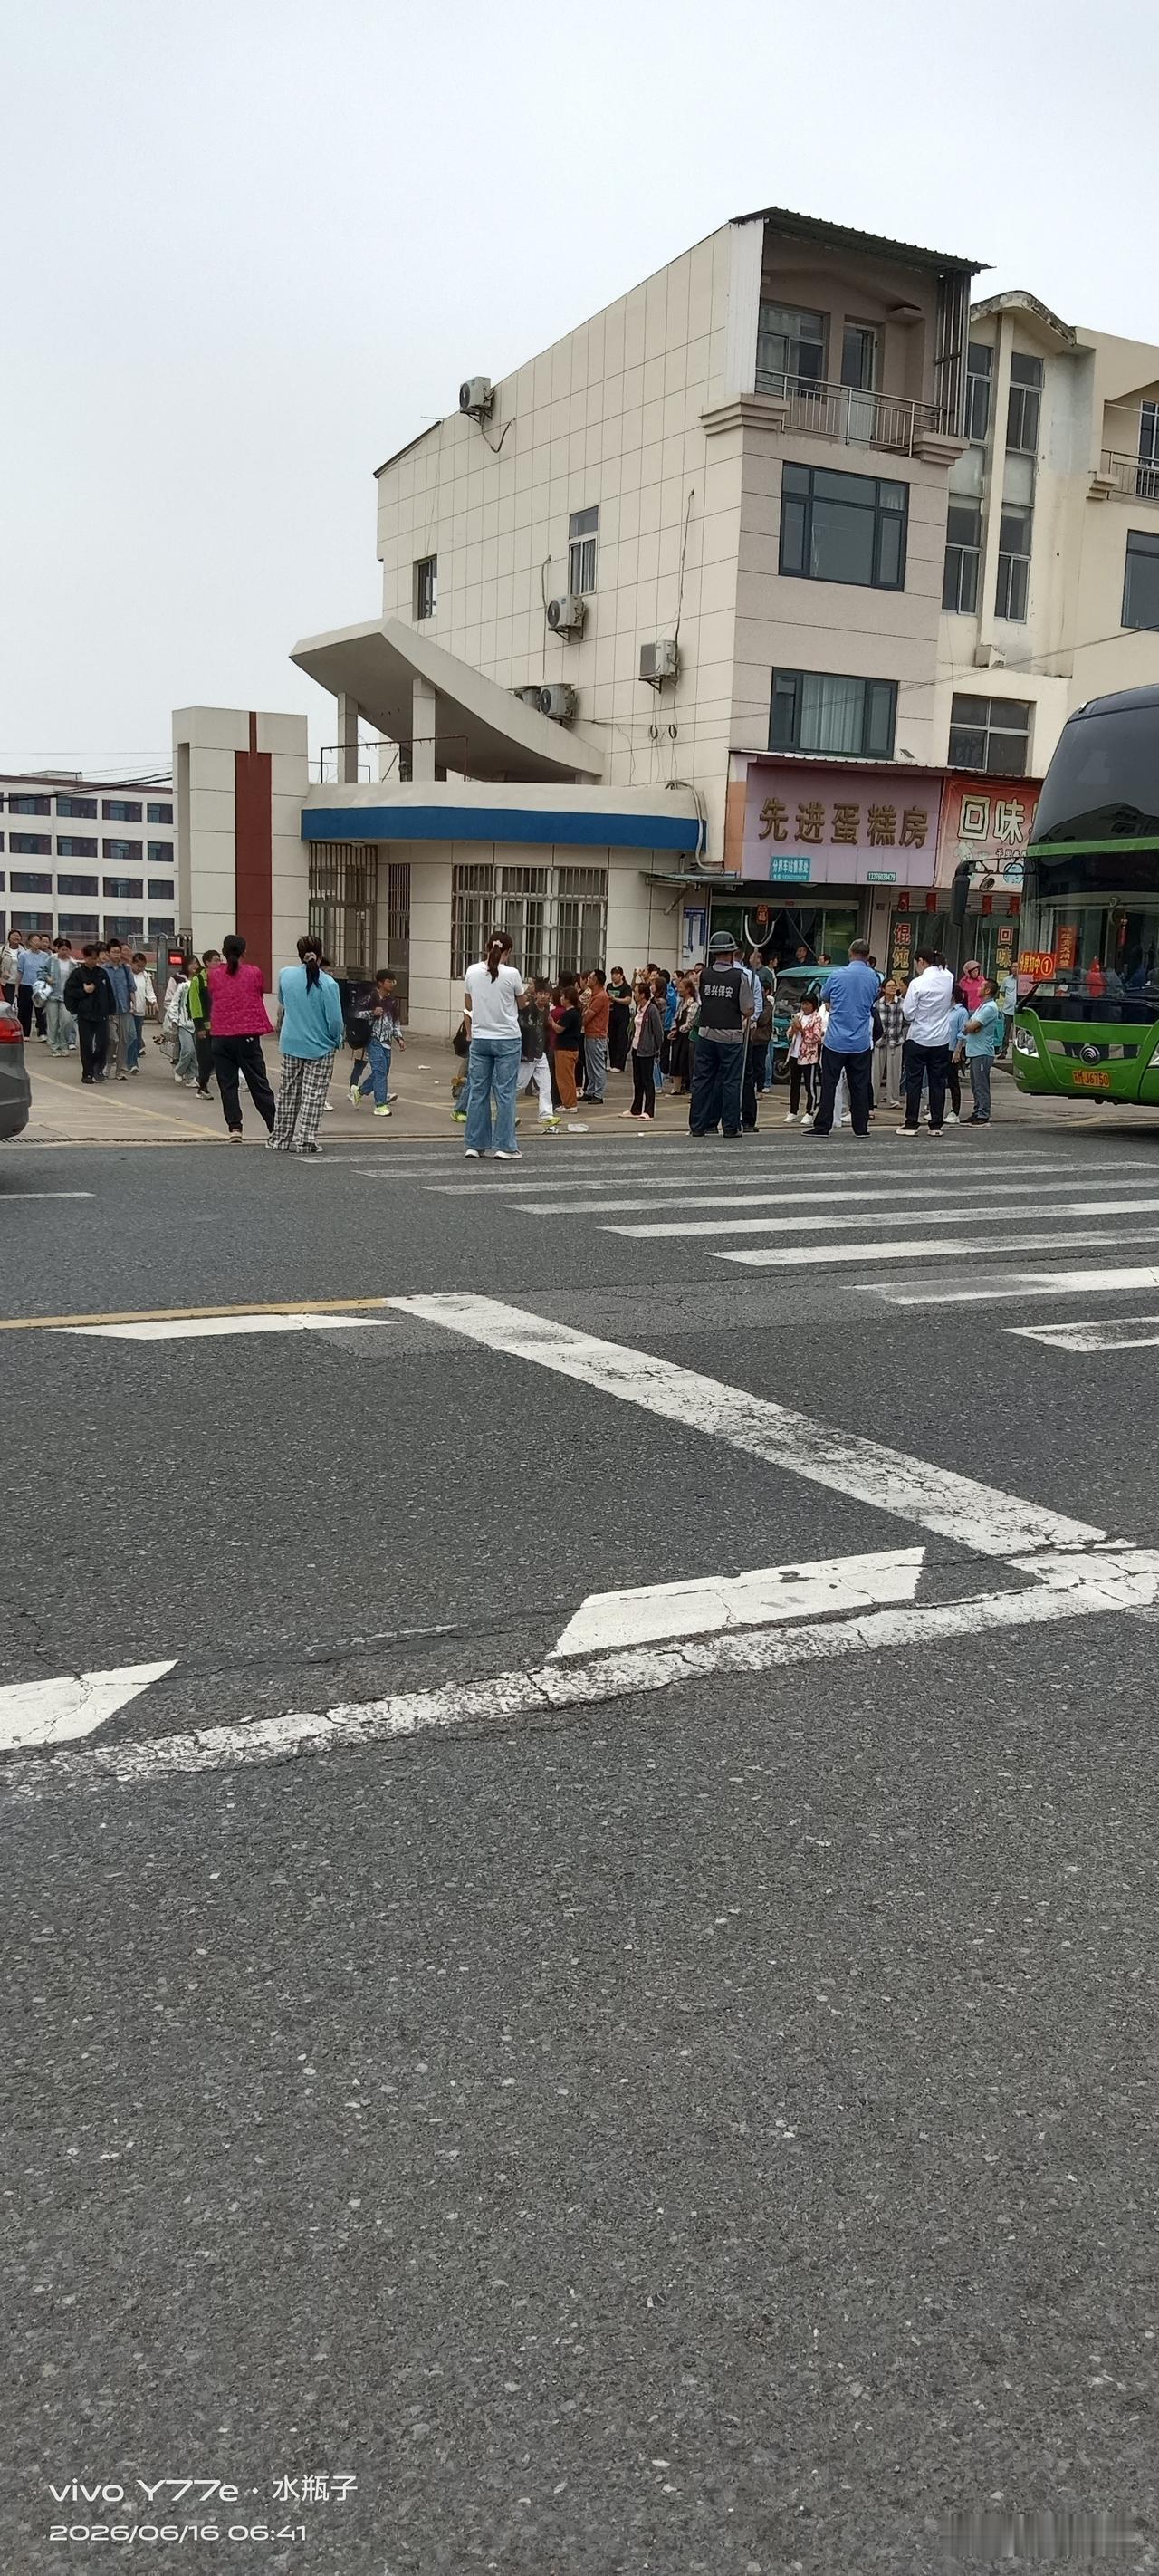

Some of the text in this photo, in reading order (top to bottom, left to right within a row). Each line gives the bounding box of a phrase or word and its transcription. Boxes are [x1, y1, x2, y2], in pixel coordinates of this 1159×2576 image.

[759, 797, 929, 849] 先进蛋糕房
[957, 793, 1038, 845] 回味
